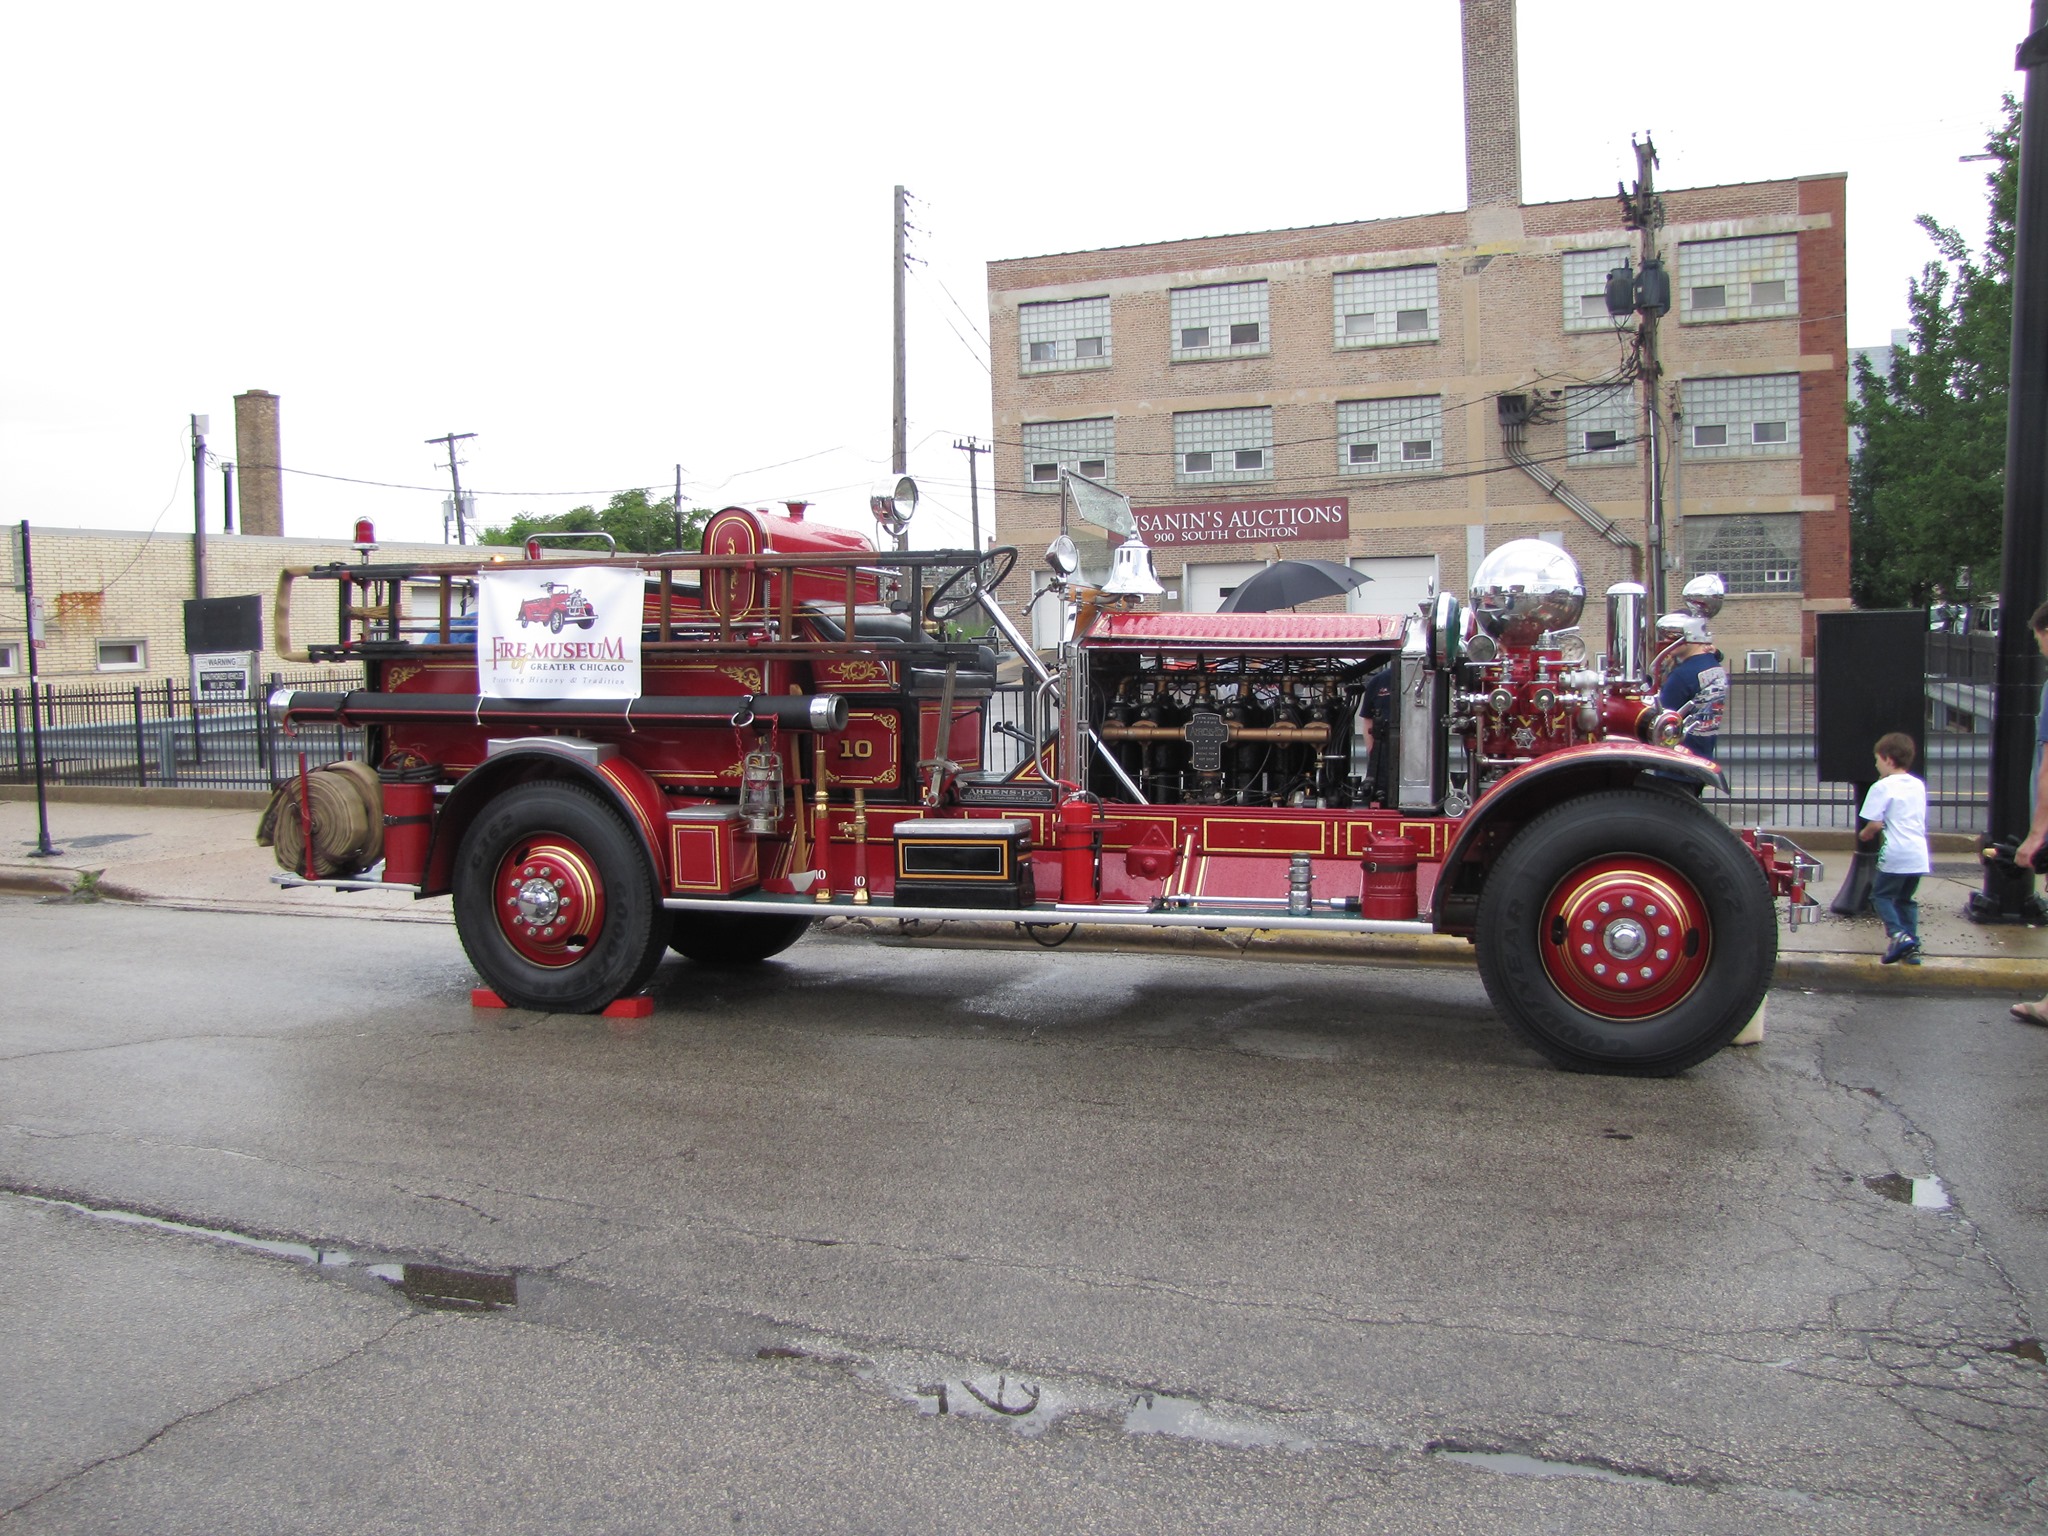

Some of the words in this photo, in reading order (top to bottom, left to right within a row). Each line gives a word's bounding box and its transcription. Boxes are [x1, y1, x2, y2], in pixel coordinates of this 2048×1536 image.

[1228, 505, 1342, 528] AUCTIONS
[1154, 532, 1175, 543] 900
[1181, 530, 1229, 541] SOUTH
[1236, 527, 1298, 539] CLINTON
[492, 636, 527, 670] FIRE
[532, 636, 625, 661] MUSEUM
[208, 657, 237, 666] WARNING
[530, 663, 576, 671] GREATER
[579, 663, 625, 672] CHICAGO
[529, 676, 566, 684] History
[583, 676, 625, 685] Tradition
[840, 739, 873, 758] 10
[968, 787, 1044, 797] AHRENS-FOX
[815, 869, 827, 880] 10
[854, 875, 866, 887] 10
